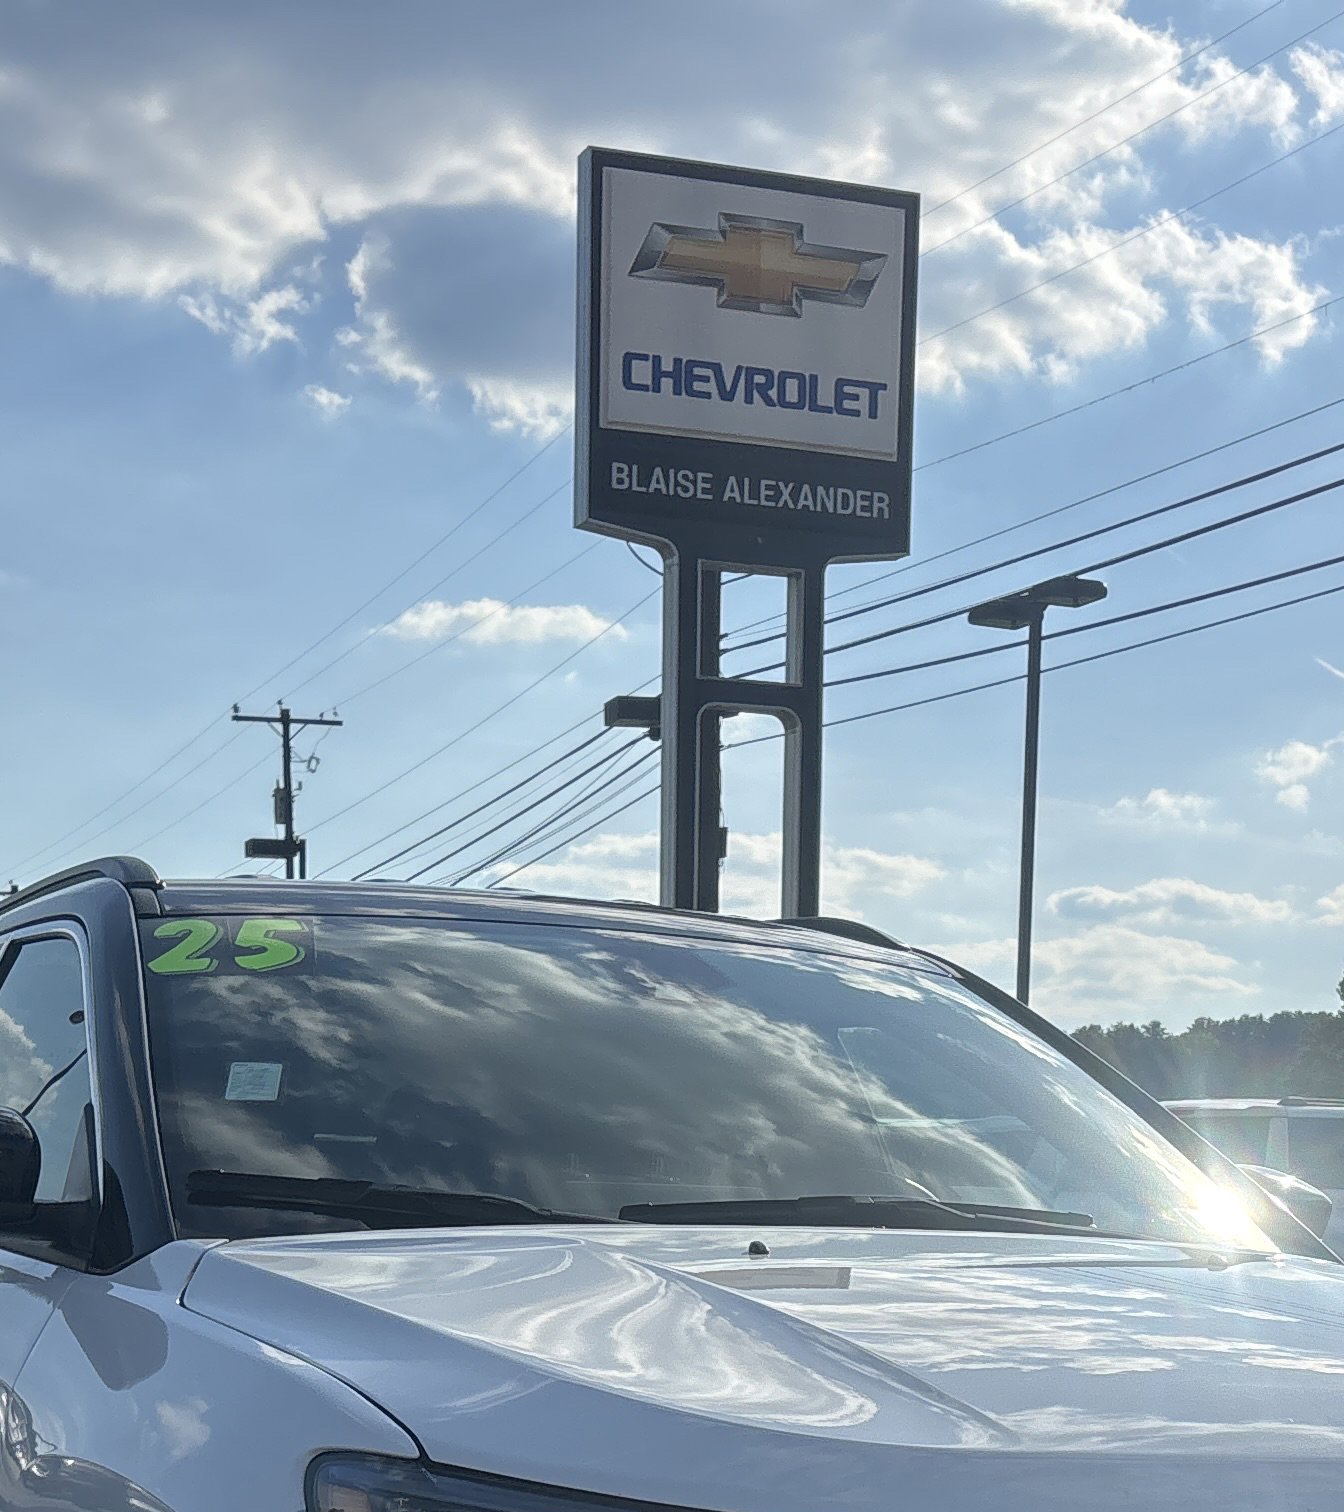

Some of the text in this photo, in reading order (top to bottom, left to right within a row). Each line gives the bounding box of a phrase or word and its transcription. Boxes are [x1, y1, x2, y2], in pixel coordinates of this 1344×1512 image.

[622, 351, 888, 420] CHEVROLET
[610, 461, 891, 520] BLAISE ALEXANDER
[147, 919, 309, 976] 25
